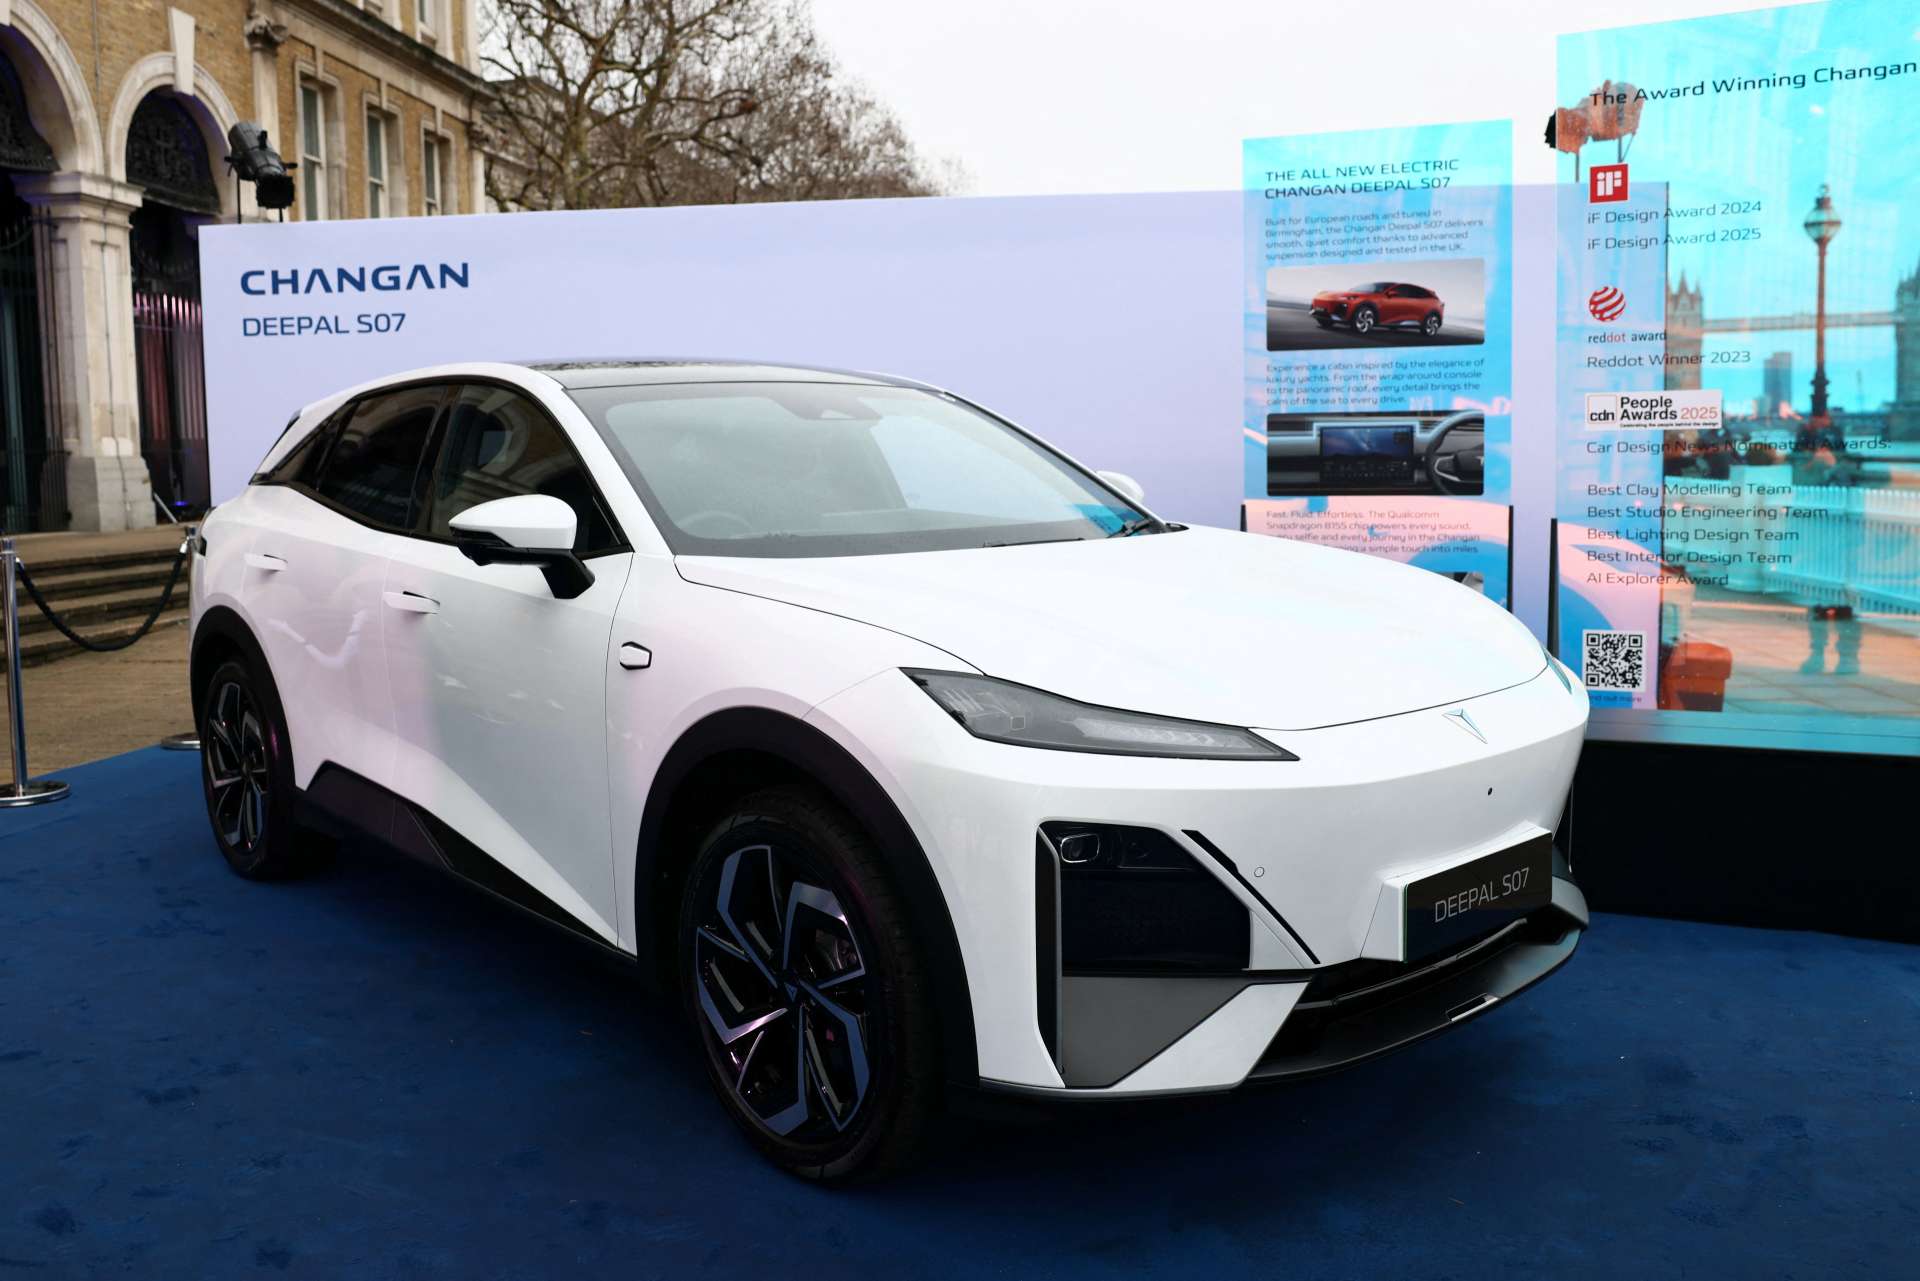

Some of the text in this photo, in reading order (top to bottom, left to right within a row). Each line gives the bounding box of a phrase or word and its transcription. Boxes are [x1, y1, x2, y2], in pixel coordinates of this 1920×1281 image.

[1591, 62, 1917, 106] The Award Winning Changan
[1265, 159, 1460, 182] THE ALL NEW ELECTRIC
[1264, 177, 1451, 199] CHANGAN DEEPAL S07
[1265, 208, 1442, 226] Built for European roads and tuned in
[1587, 201, 1762, 224] iF Design Award 2024
[1326, 226, 1341, 235] the
[1343, 222, 1385, 234] Changan
[1388, 221, 1421, 232] Deepal
[1423, 219, 1442, 229] S07
[1444, 218, 1484, 228] delivers
[1306, 238, 1329, 249] quiet
[1331, 235, 1371, 246] comfort
[1373, 233, 1406, 243] thanks
[1407, 233, 1419, 242] to
[1420, 230, 1469, 241] advanced
[1587, 228, 1761, 250] iF Design Award 2025
[1265, 250, 1317, 261] suspension
[1319, 247, 1363, 259] designed
[1365, 246, 1383, 255] and
[1385, 244, 1417, 254] tested
[1419, 243, 1428, 252] in
[1430, 242, 1446, 251] the
[240, 262, 469, 295] CHANGAN
[242, 313, 407, 337] DEEPAL S07
[1588, 330, 1667, 344] reddot award
[1328, 361, 1353, 371] cabin
[1355, 360, 1393, 371] inspired
[1395, 360, 1408, 369] by
[1410, 359, 1426, 368] the
[1428, 359, 1472, 369] elegance
[1474, 357, 1485, 367] of
[1587, 350, 1751, 368] Reddot Winner 2023
[1333, 372, 1359, 381] From
[1361, 371, 1377, 381] the
[1444, 370, 1482, 379] console
[1266, 386, 1277, 395] to
[1279, 386, 1294, 395] the
[1296, 385, 1344, 396] panoramic
[1372, 384, 1400, 393] every
[1402, 382, 1430, 392] detail
[1431, 381, 1462, 392] brings
[1463, 381, 1480, 391] the
[1290, 396, 1301, 406] of
[1303, 396, 1318, 405] the
[1320, 397, 1337, 405] sea
[1338, 396, 1349, 405] to
[1350, 397, 1378, 406] every
[1620, 395, 1673, 412] People
[1590, 406, 1719, 422] cdn Awards 2025
[1586, 441, 1613, 454] Car
[1617, 439, 1669, 455] Design
[1725, 436, 1817, 450] Nominatd
[1823, 436, 1892, 450] Awards:
[1587, 482, 1792, 498] Best Clay Modelling Team
[1369, 510, 1386, 518] The
[1388, 510, 1440, 519] Qualcomm
[1587, 505, 1829, 520] Best Studio Engineering Team
[1266, 521, 1322, 531] Snapdragon
[1348, 521, 1368, 531] chip
[1368, 523, 1407, 531] powers
[1409, 522, 1437, 531] every
[1294, 533, 1318, 541] selfie
[1320, 532, 1339, 541] and
[1340, 533, 1367, 542] every
[1368, 532, 1406, 543] journey
[1407, 532, 1417, 541] in
[1419, 532, 1436, 541] the
[1437, 531, 1481, 542] Changan
[1587, 527, 1800, 543] Best Lighting Design Team
[1369, 543, 1400, 553] simple
[1401, 543, 1430, 552] touch
[1431, 543, 1452, 553] into
[1587, 550, 1792, 566] Best Interior Design Team
[1586, 571, 1729, 586] AI Explorer Award
[1434, 867, 1530, 923] DEEPAL S07
